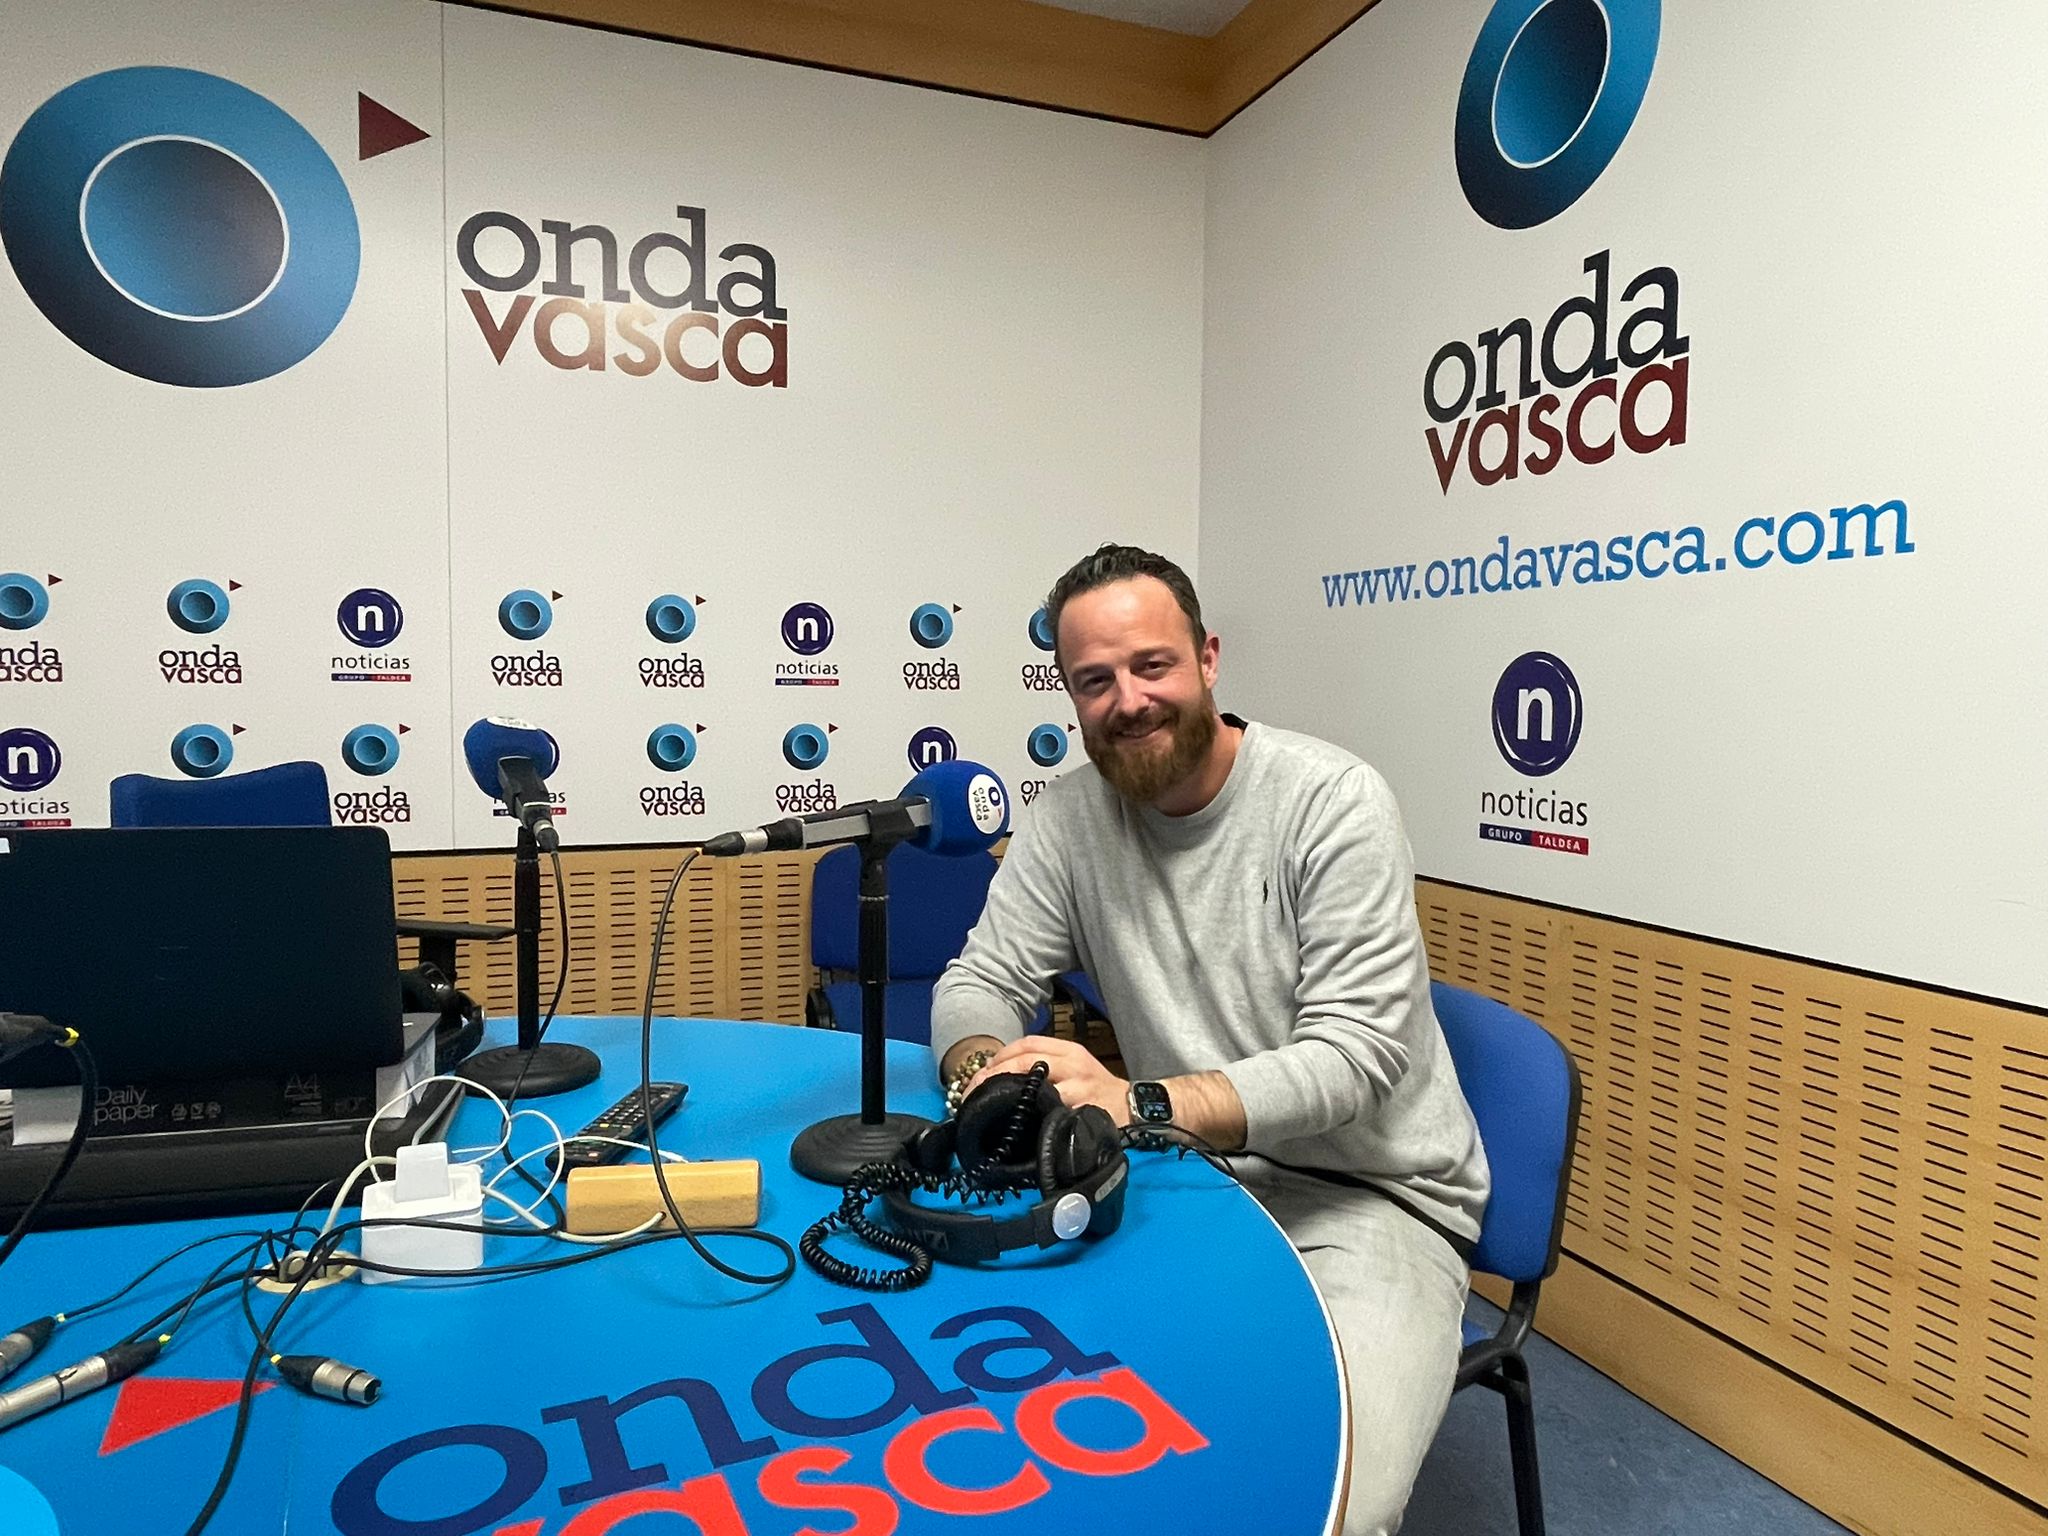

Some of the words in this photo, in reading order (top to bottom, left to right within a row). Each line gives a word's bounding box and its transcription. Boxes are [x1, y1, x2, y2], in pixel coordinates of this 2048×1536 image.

[457, 205, 787, 320] onda
[461, 288, 788, 388] vasca
[1423, 249, 1690, 423] onda
[1424, 357, 1690, 496] vasca
[1322, 500, 1915, 608] www.ondavasca.com
[0, 640, 62, 665] nda
[159, 644, 242, 668] onda
[331, 653, 410, 669] noticias
[491, 650, 562, 671] onda
[0, 665, 63, 683] asca
[638, 653, 704, 674] onda
[776, 660, 838, 675] noticias
[903, 658, 959, 677] onda
[161, 667, 242, 684] vasca
[492, 670, 562, 686] vasca
[640, 672, 704, 688] vasca
[904, 675, 960, 690] vasca
[1023, 678, 1063, 691] vasc
[334, 785, 409, 809] onda
[639, 781, 705, 802] onda
[776, 779, 836, 799] onda
[0, 797, 70, 815] oticias
[336, 807, 410, 824] vasca
[640, 800, 705, 816] vasca
[777, 797, 836, 813] vasca
[1482, 788, 1588, 826] noticias
[1488, 827, 1522, 842] GRUPO
[1539, 835, 1581, 850] TALDEA
[95, 1086, 148, 1107] Daily
[95, 1101, 158, 1125] paper
[330, 1301, 1125, 1536] onda
